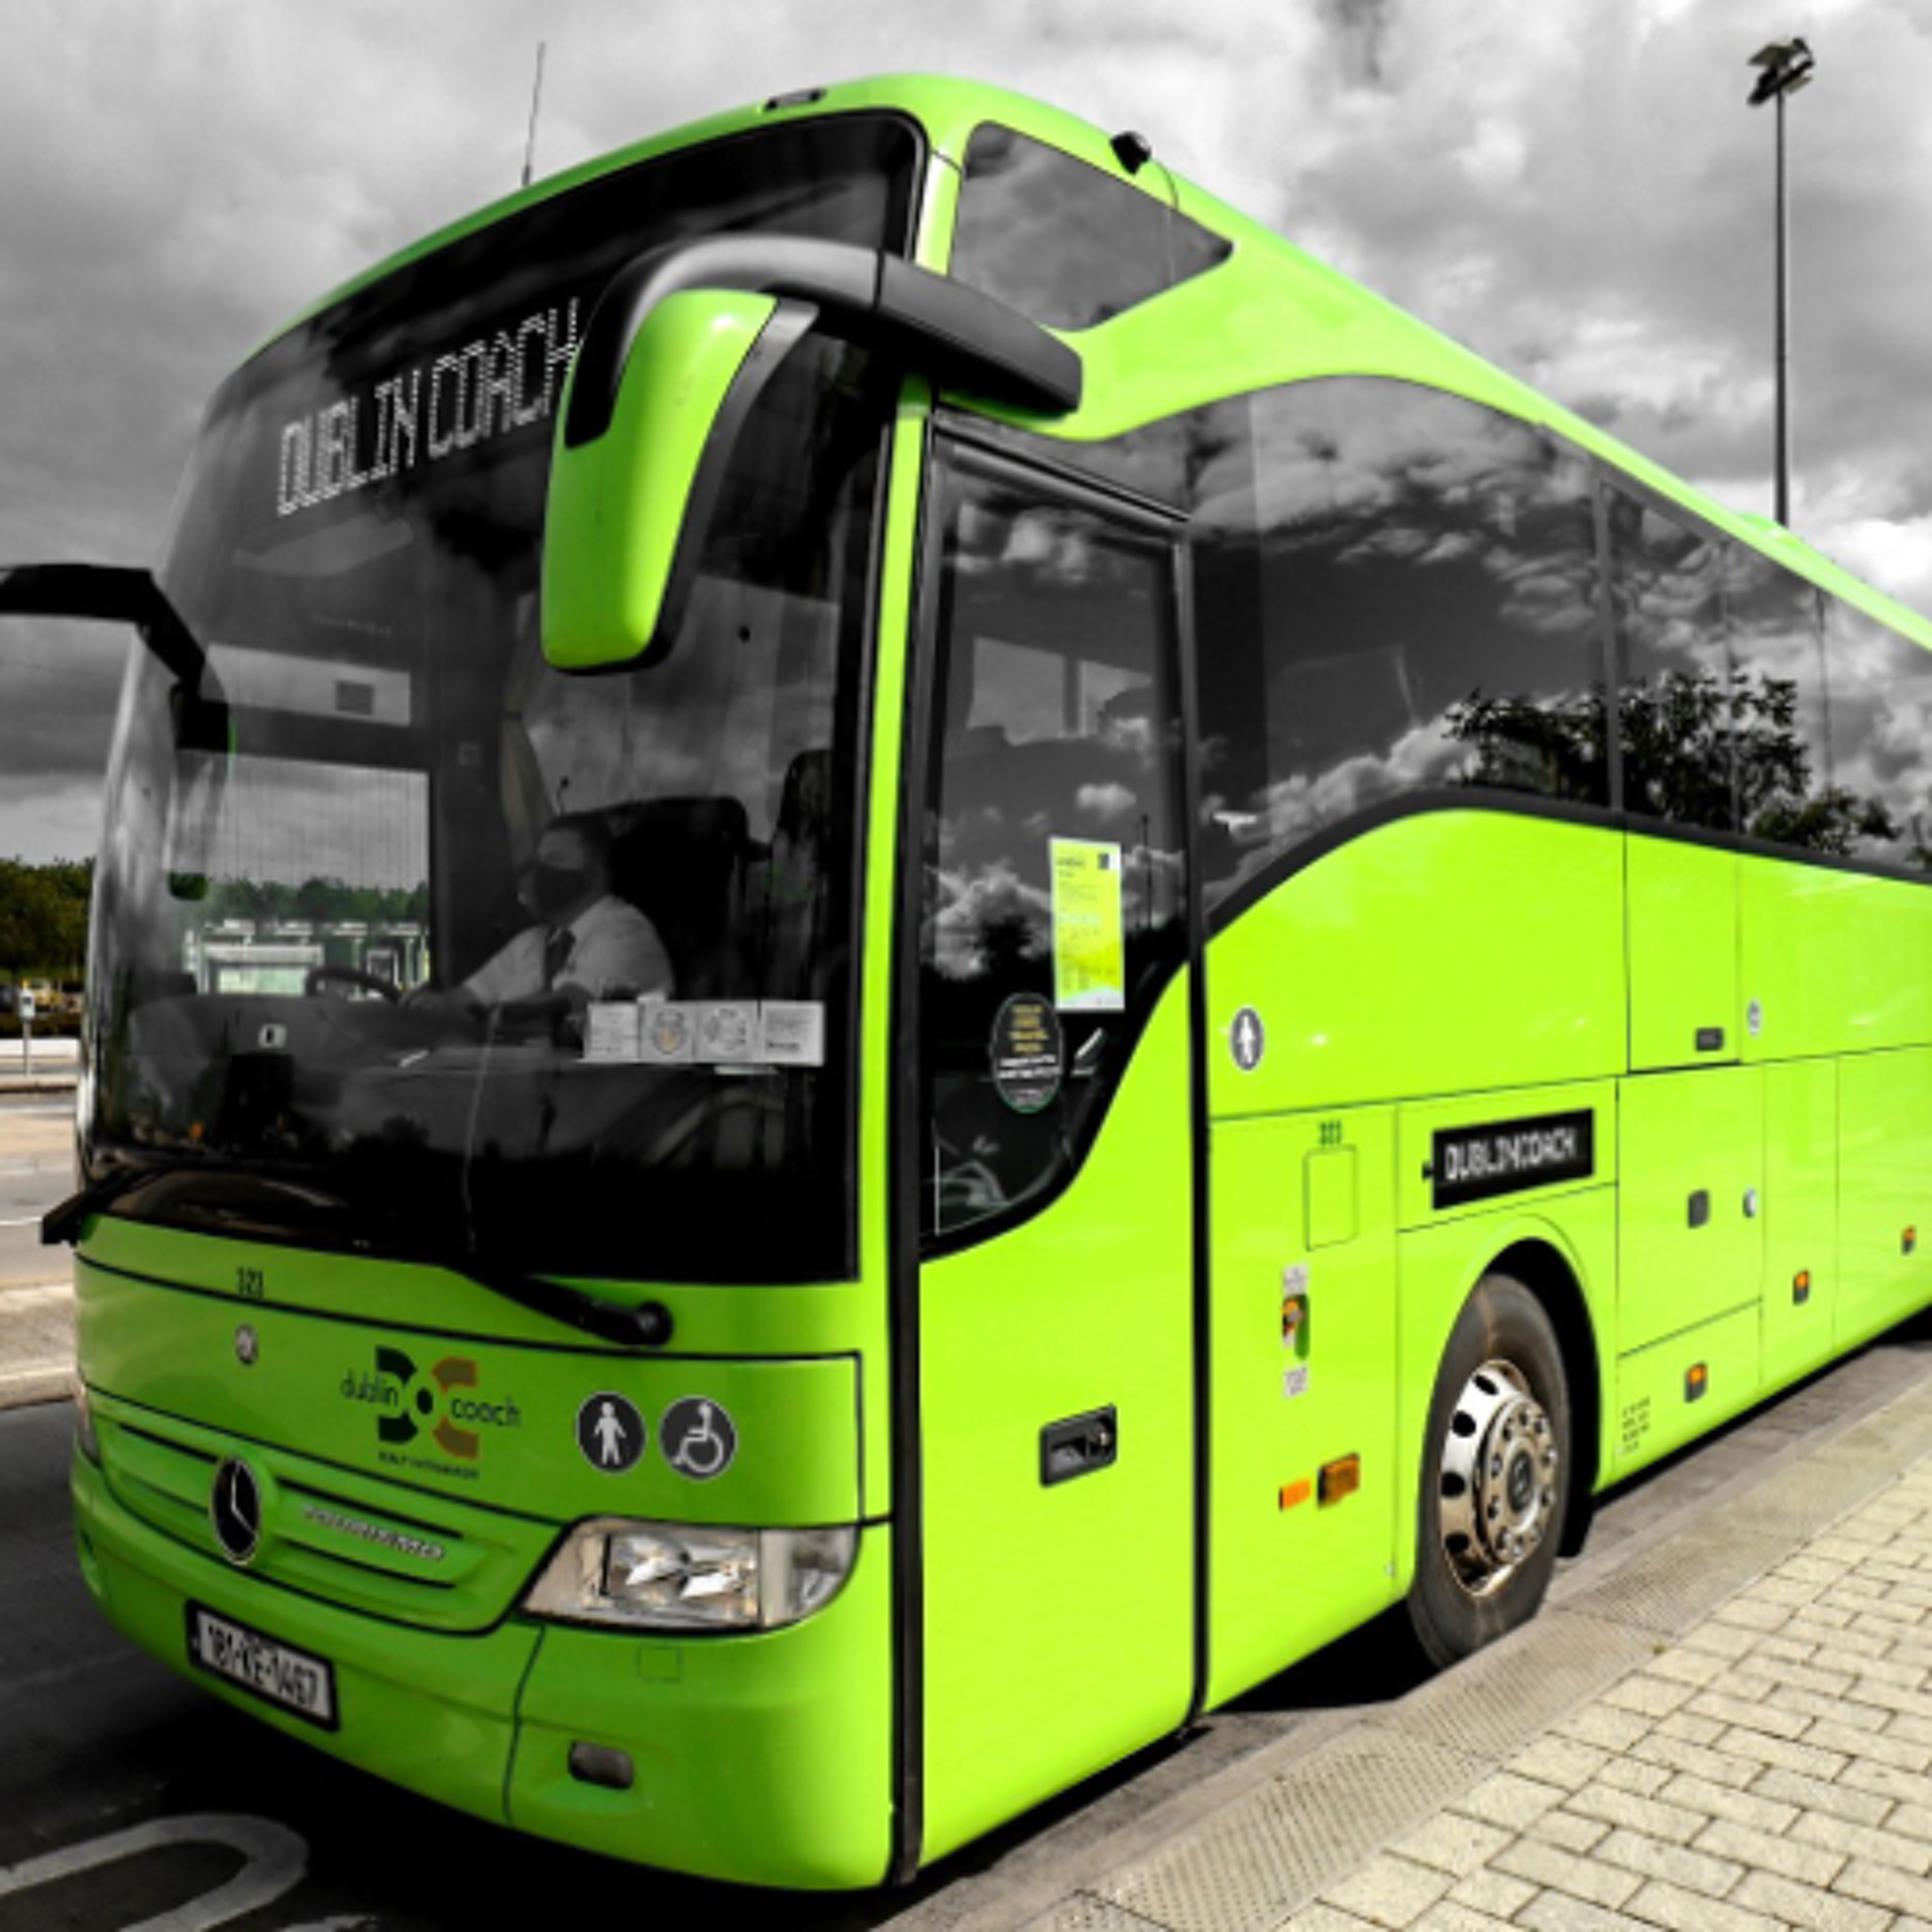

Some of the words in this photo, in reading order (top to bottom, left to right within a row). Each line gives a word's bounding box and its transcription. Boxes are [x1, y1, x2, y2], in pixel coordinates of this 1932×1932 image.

[277, 368, 421, 517] DUBLIN
[428, 297, 580, 459] COACH
[340, 1368, 399, 1408] dublin
[451, 1395, 523, 1427] coach
